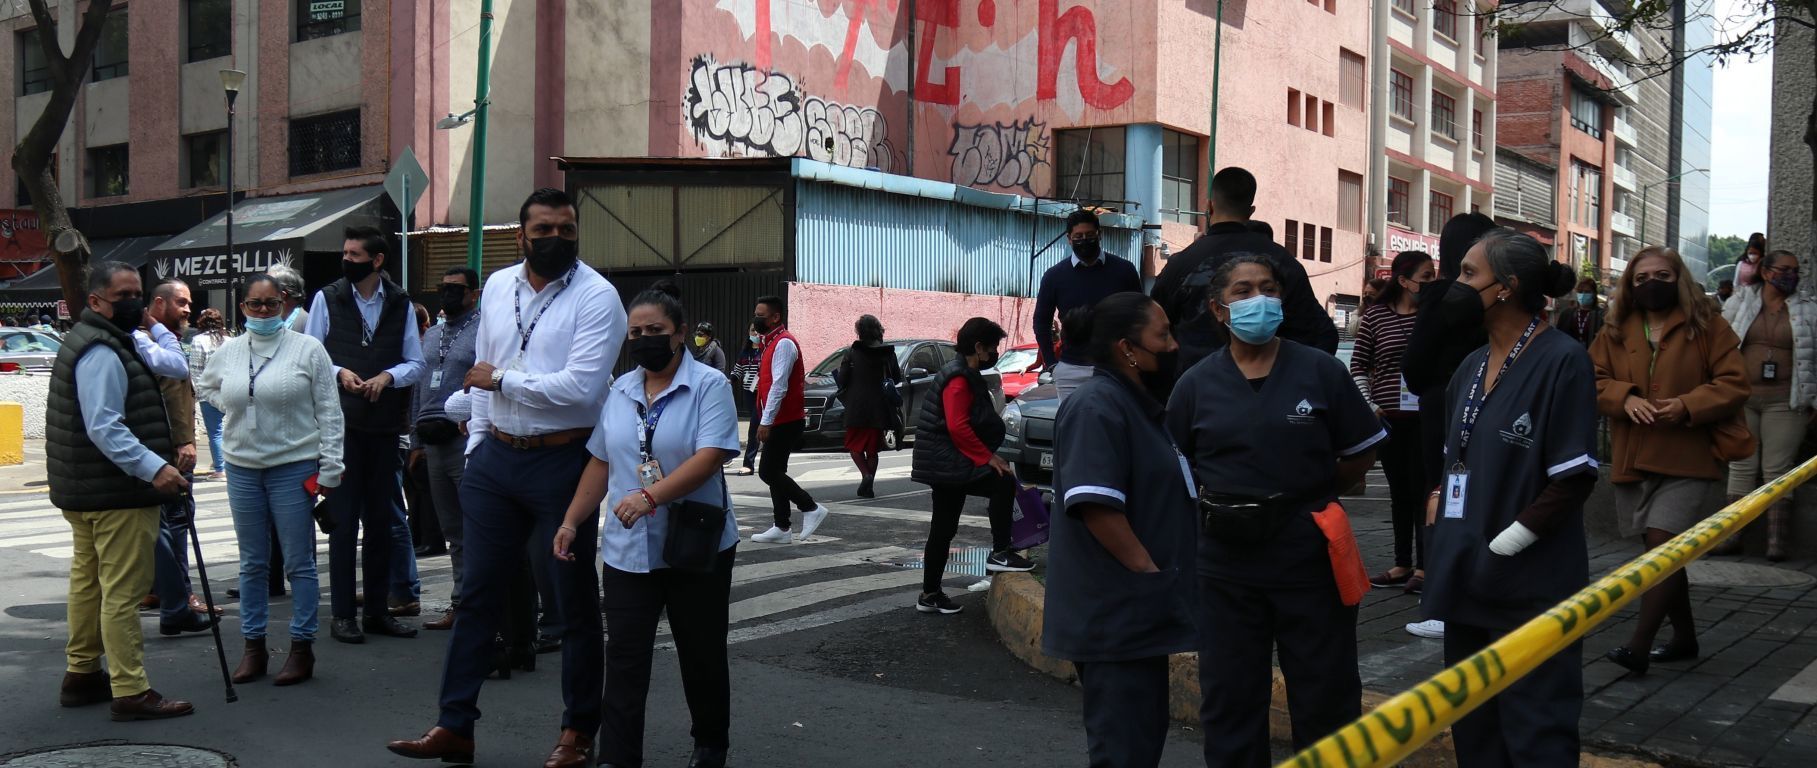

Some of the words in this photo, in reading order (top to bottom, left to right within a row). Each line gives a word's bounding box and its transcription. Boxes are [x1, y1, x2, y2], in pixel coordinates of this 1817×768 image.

[174, 250, 272, 278] MEZCALLI
[1524, 322, 1537, 338] SAT
[1509, 341, 1522, 358] SAT
[1469, 406, 1479, 424] SAT
